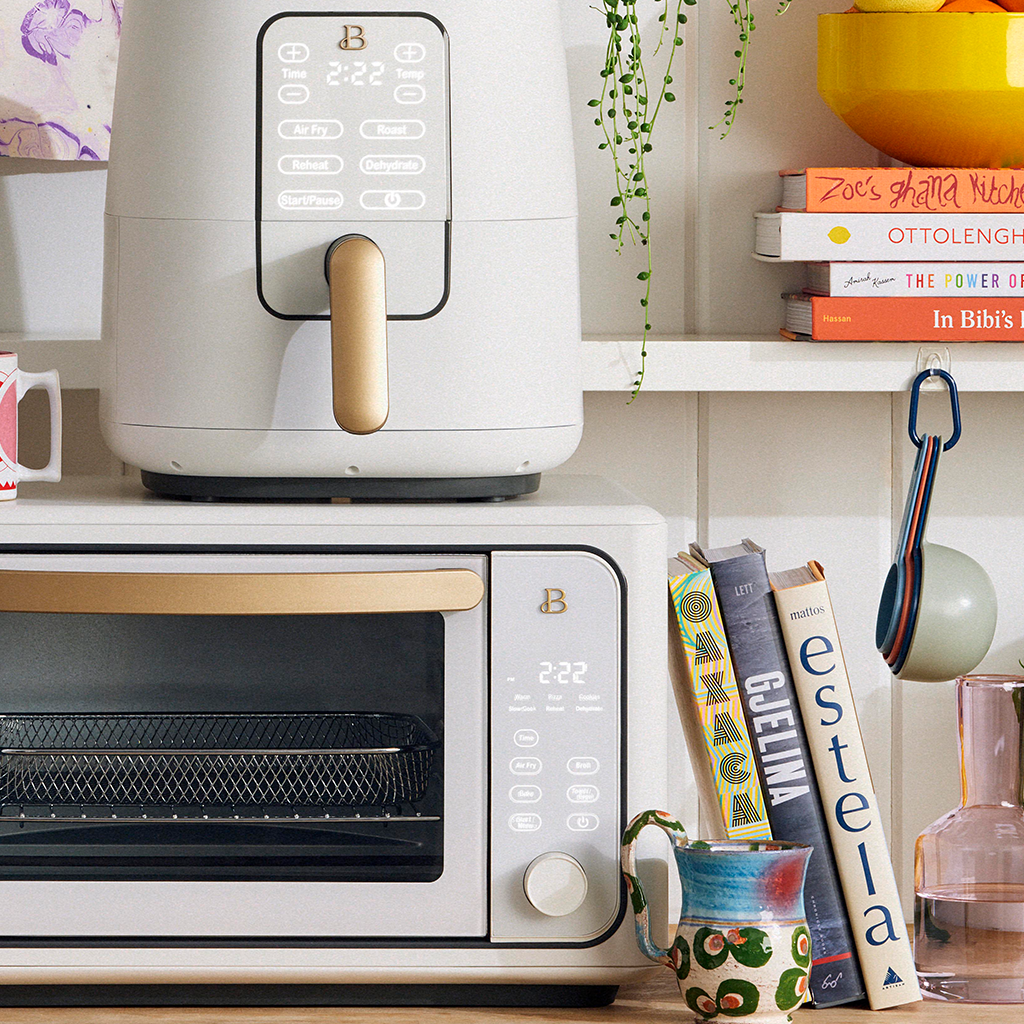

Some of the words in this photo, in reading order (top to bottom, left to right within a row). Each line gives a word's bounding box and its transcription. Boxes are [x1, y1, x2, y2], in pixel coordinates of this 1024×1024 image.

[339, 24, 368, 51] B
[281, 68, 307, 79] Time
[326, 61, 385, 86] 2:22
[395, 68, 425, 82] Temp
[293, 124, 310, 136] Air
[311, 124, 329, 137] Fry
[376, 124, 407, 136] Roast
[292, 159, 329, 171] Reheat
[365, 159, 419, 173] Dehydrate
[280, 194, 342, 207] Start/Pause
[888, 227, 1024, 244] OTTOLENGH
[906, 273, 935, 289] THE
[945, 273, 1000, 289] POWER
[822, 314, 852, 323] Hassan
[933, 309, 953, 329] In
[960, 308, 1014, 330] Bibi's
[734, 582, 754, 596] LETT
[540, 587, 568, 614] B
[790, 606, 825, 621] mattos
[539, 661, 588, 684] 2:22
[680, 590, 762, 828] OAXACA
[744, 670, 811, 807] GJELINA
[798, 634, 901, 947] estela
